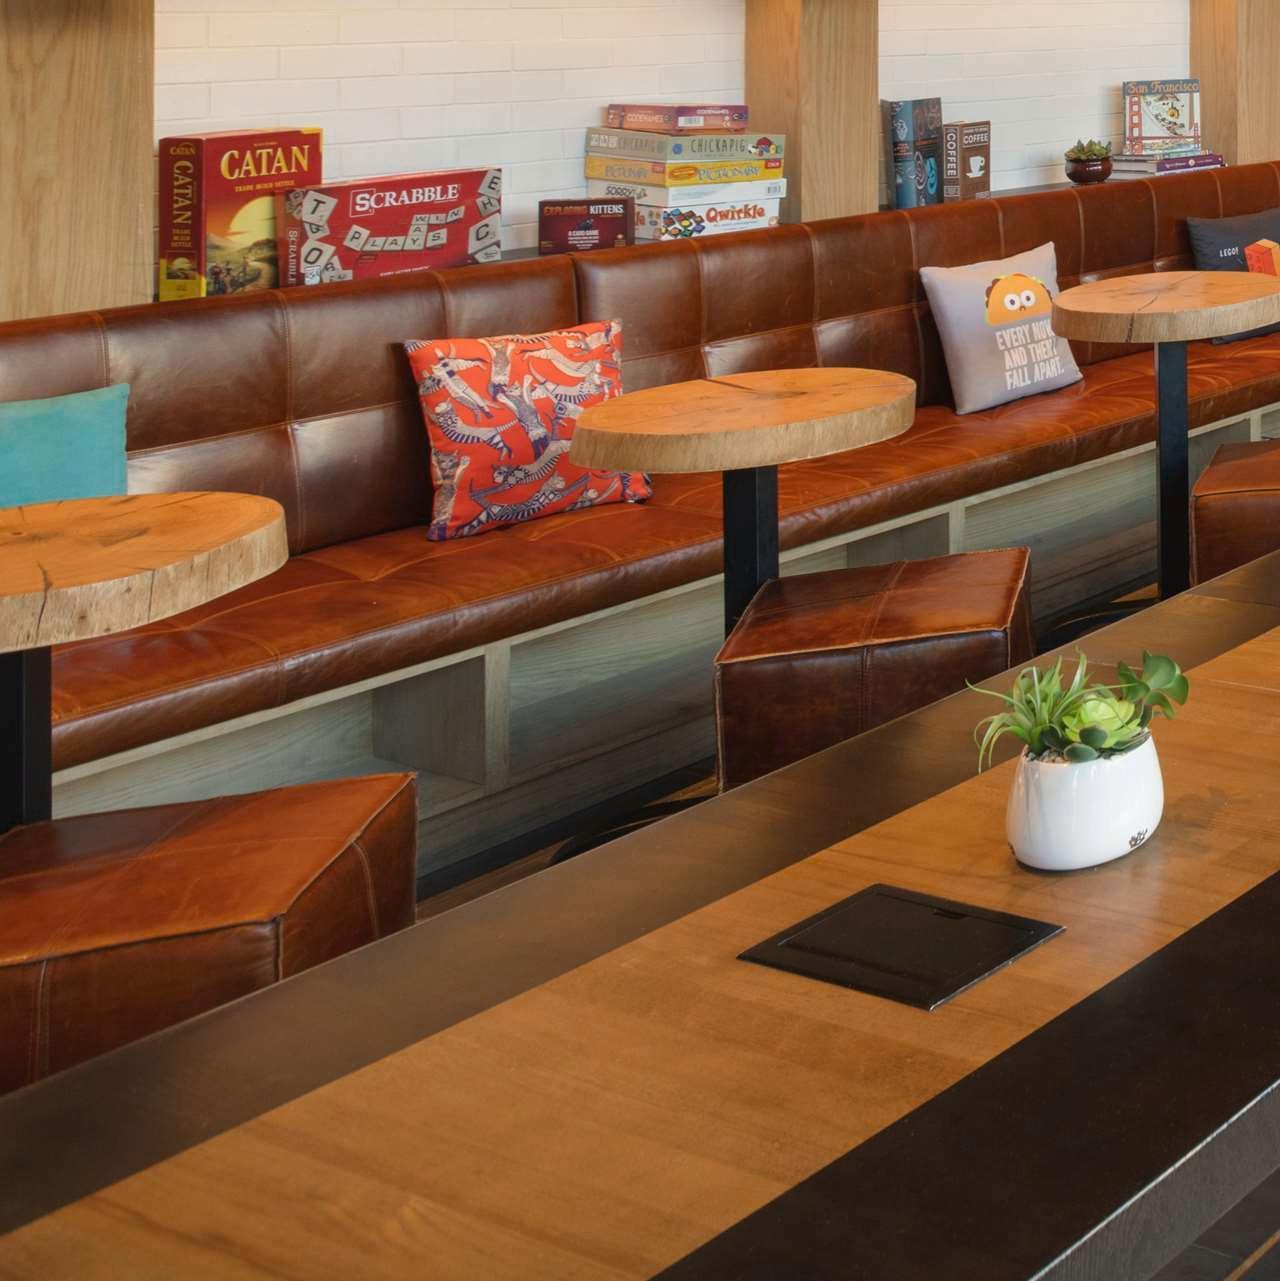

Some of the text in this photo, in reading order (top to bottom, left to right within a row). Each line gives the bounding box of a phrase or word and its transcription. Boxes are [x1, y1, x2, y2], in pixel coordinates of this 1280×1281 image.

[1128, 80, 1200, 94] San Francisco
[690, 138, 746, 154] CHICKAPIG
[963, 132, 989, 145] COFFEE
[170, 146, 196, 156] CATAN
[220, 144, 310, 180] CATAN
[946, 132, 957, 176] COFFEE
[173, 160, 194, 225] CATAN
[355, 183, 461, 212] SCRABBLE
[589, 204, 625, 215] KITTENS
[705, 203, 766, 225] Qwirkle
[349, 228, 443, 248] PLAYS
[995, 323, 1031, 351] EVERY
[1004, 346, 1028, 370] AND
[1005, 356, 1065, 391] FALL APART.
